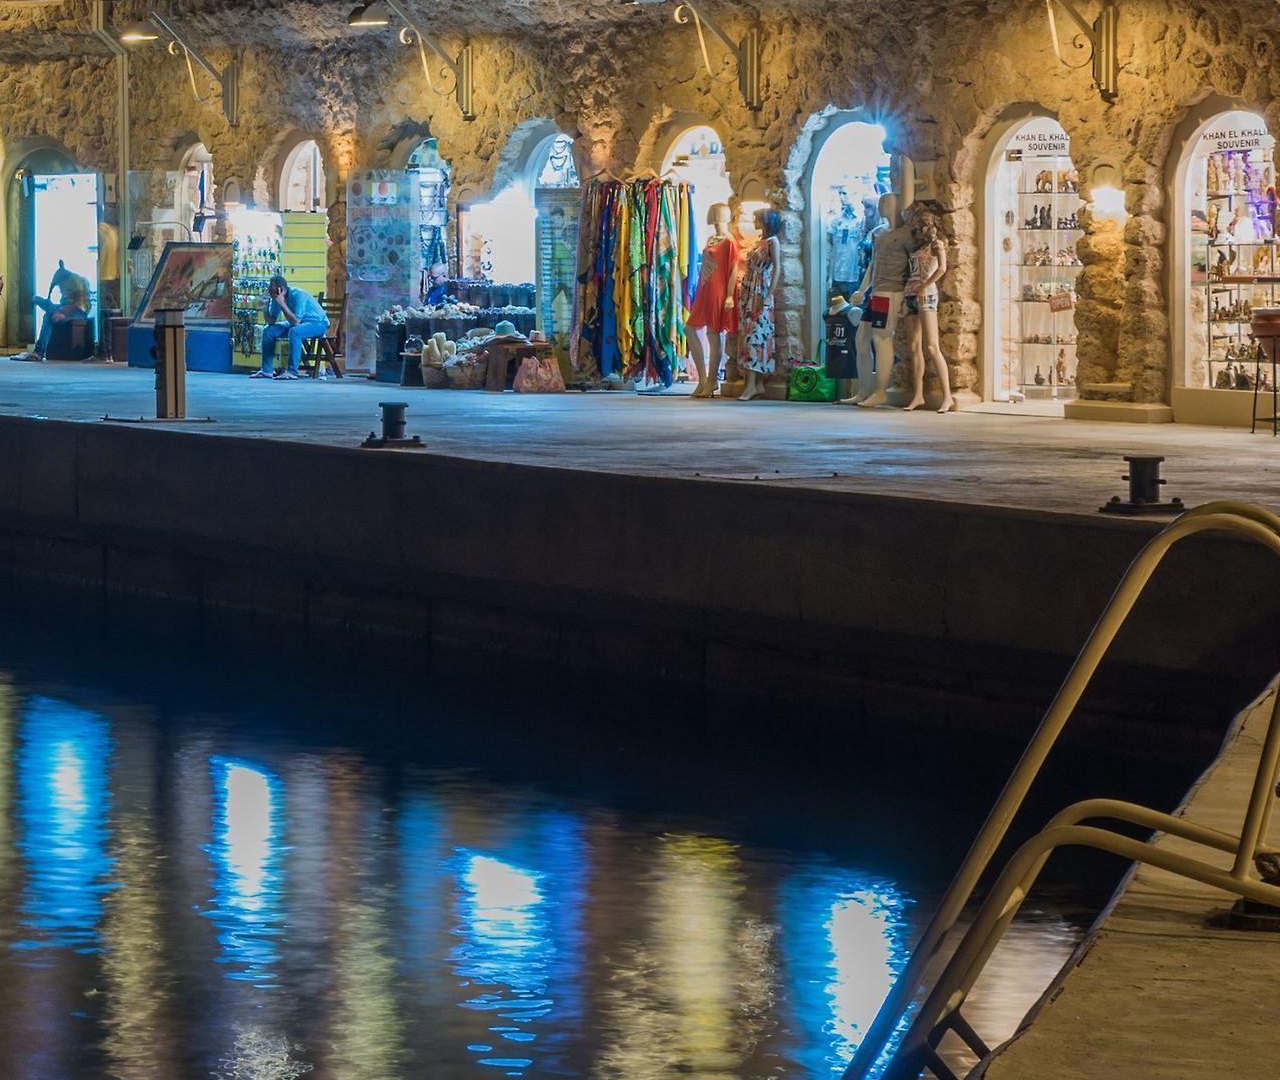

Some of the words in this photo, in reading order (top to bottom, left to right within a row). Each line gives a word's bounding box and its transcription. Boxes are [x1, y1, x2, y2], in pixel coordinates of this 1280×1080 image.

[1015, 134, 1036, 142] KHAN
[1038, 133, 1047, 141] EL
[1202, 131, 1226, 140] KHAN
[1228, 130, 1239, 138] EL
[1028, 142, 1066, 151] SOUVENIR
[1217, 138, 1261, 150] SOUVENIR
